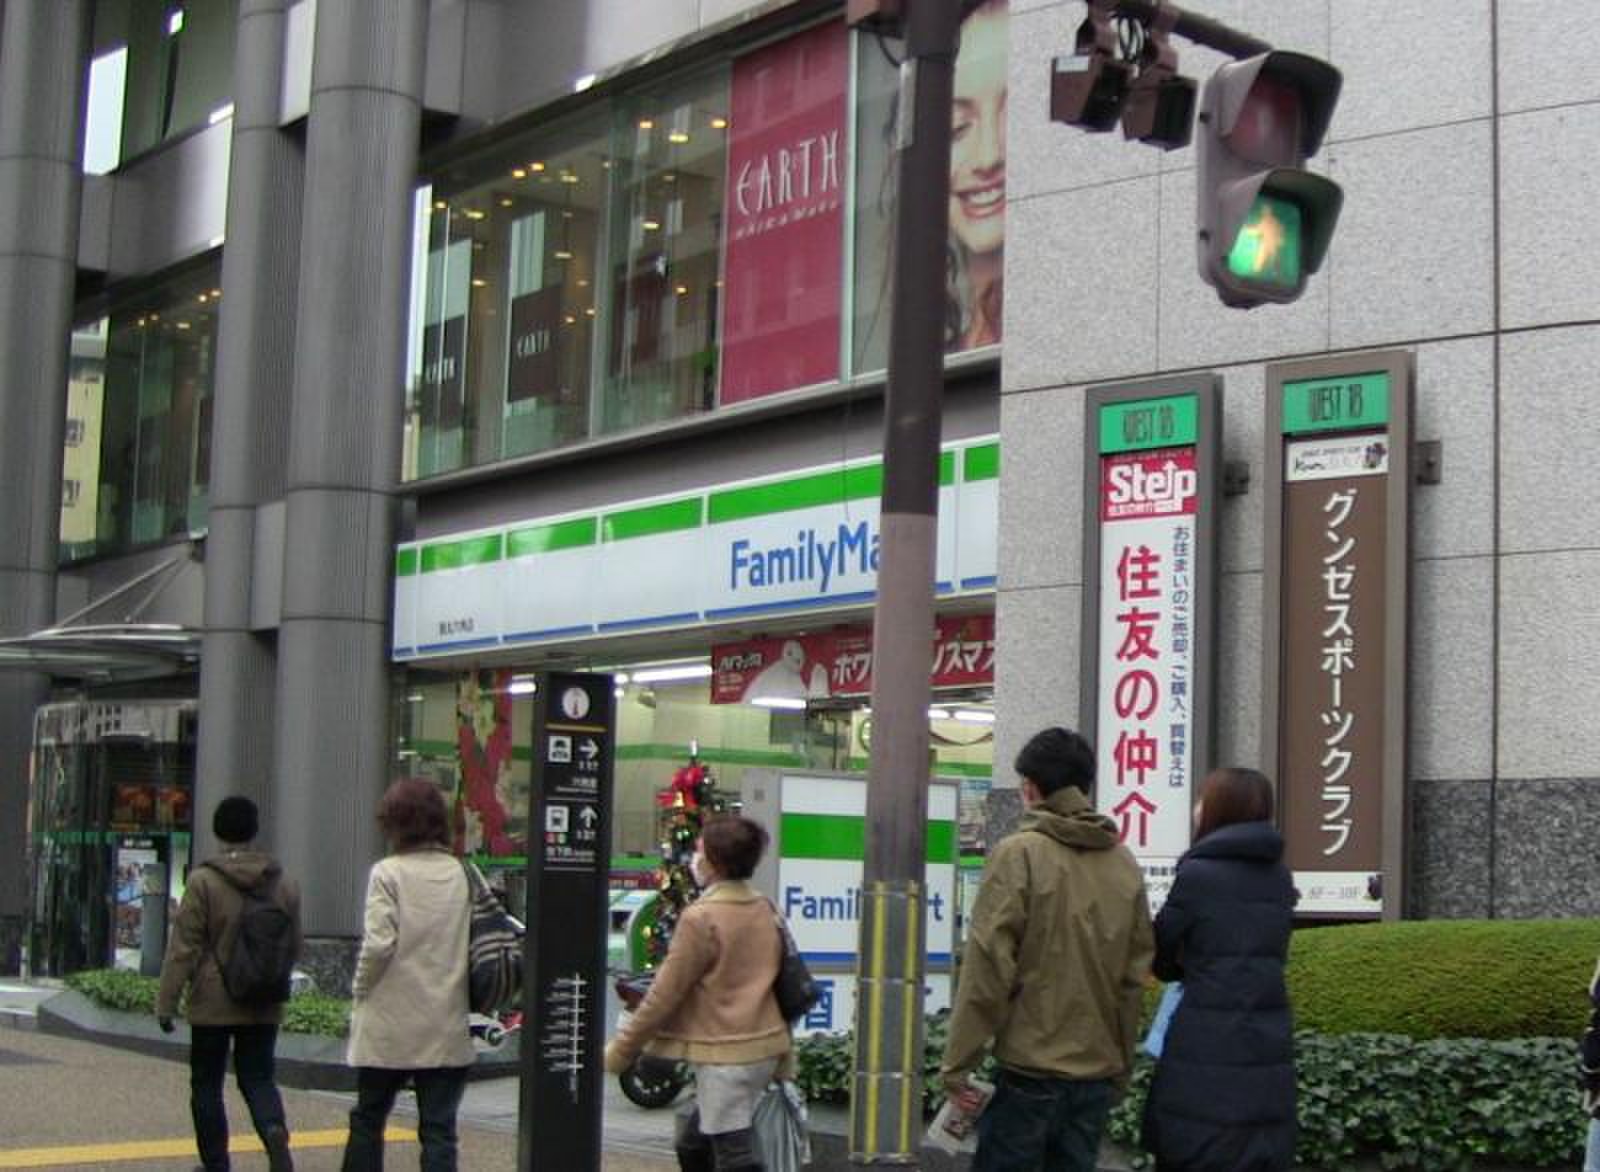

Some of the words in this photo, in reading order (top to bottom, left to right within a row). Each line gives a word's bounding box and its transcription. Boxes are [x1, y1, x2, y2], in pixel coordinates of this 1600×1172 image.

[736, 127, 838, 217] EARTH
[1108, 459, 1197, 513] Step
[1113, 545, 1161, 847] 住友の仲介
[1320, 488, 1357, 856] グンゼスポーツクラブ
